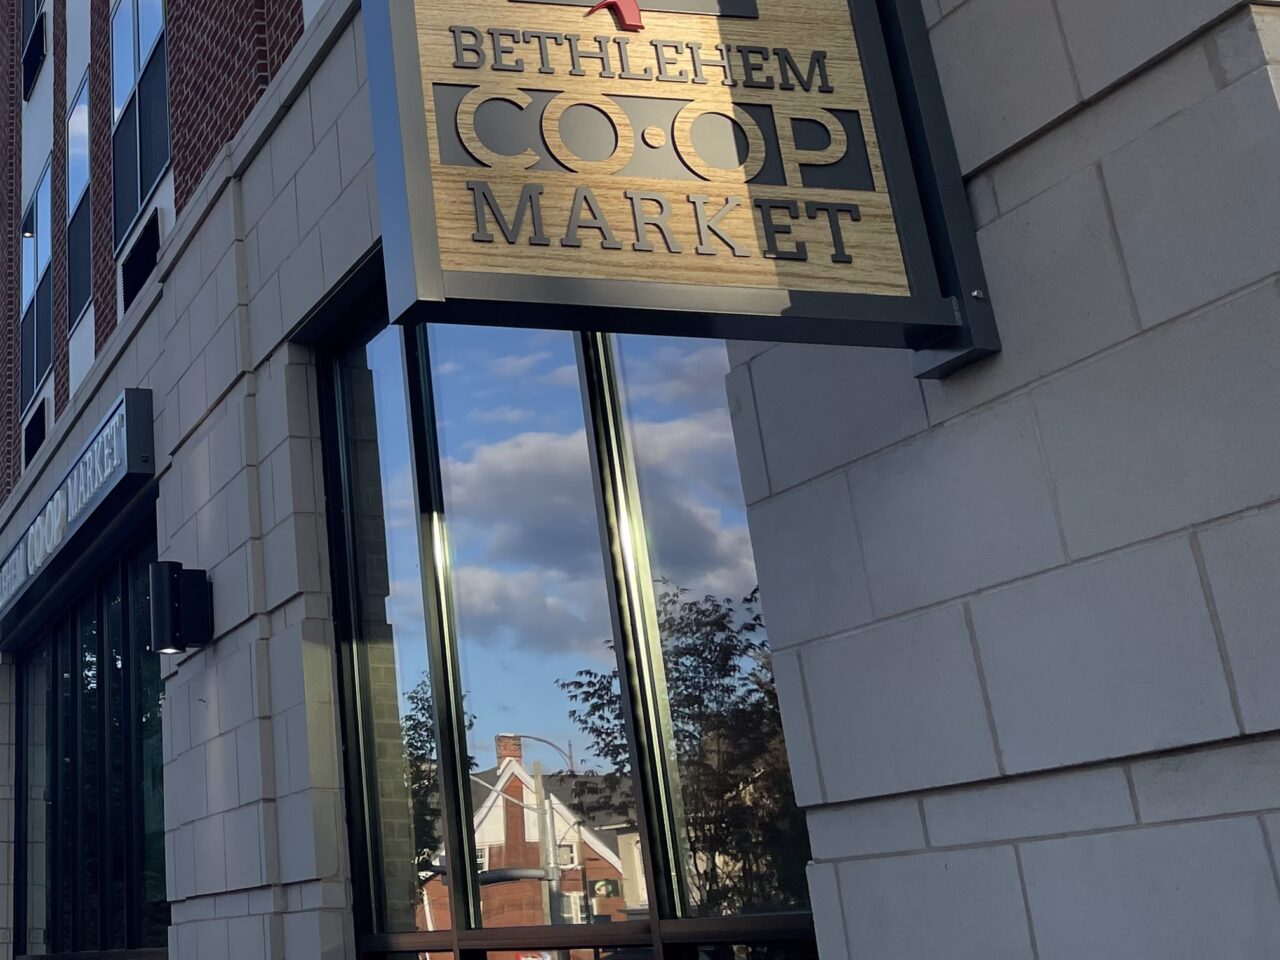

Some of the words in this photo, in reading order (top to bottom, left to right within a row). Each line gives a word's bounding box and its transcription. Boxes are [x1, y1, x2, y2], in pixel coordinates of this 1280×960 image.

[449, 25, 834, 93] BETHLEHEM
[467, 181, 861, 264] MARKET
[67, 414, 122, 522] MARKET
